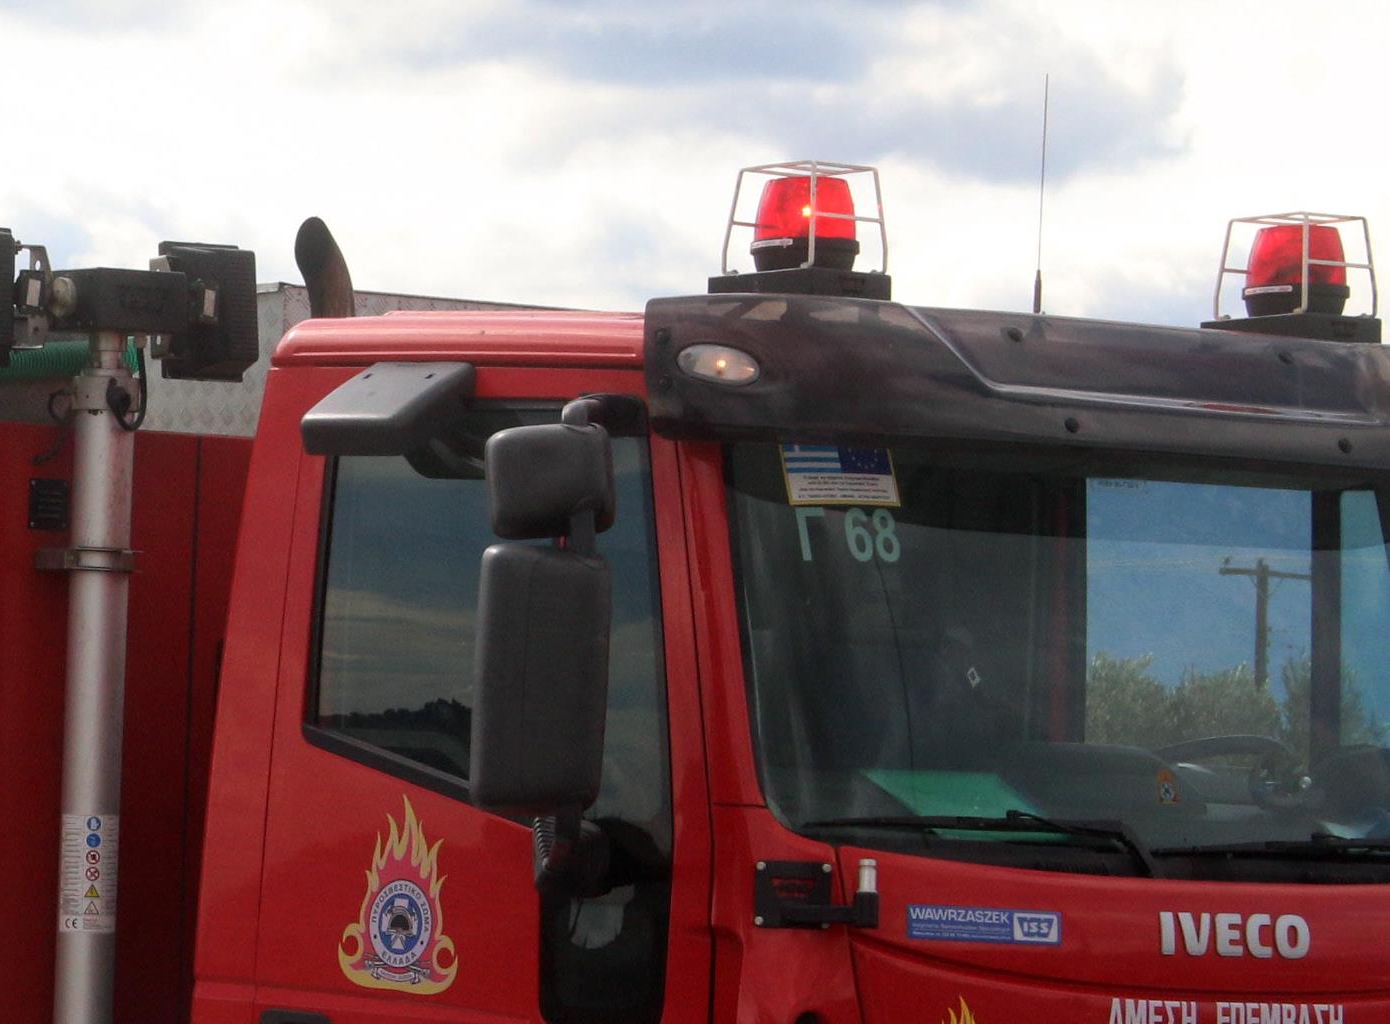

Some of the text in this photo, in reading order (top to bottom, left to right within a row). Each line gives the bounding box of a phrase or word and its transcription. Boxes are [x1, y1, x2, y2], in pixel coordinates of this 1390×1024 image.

[844, 507, 901, 563] 68
[910, 906, 1010, 924] WAWRZASZEK
[1159, 911, 1311, 959] IVECO
